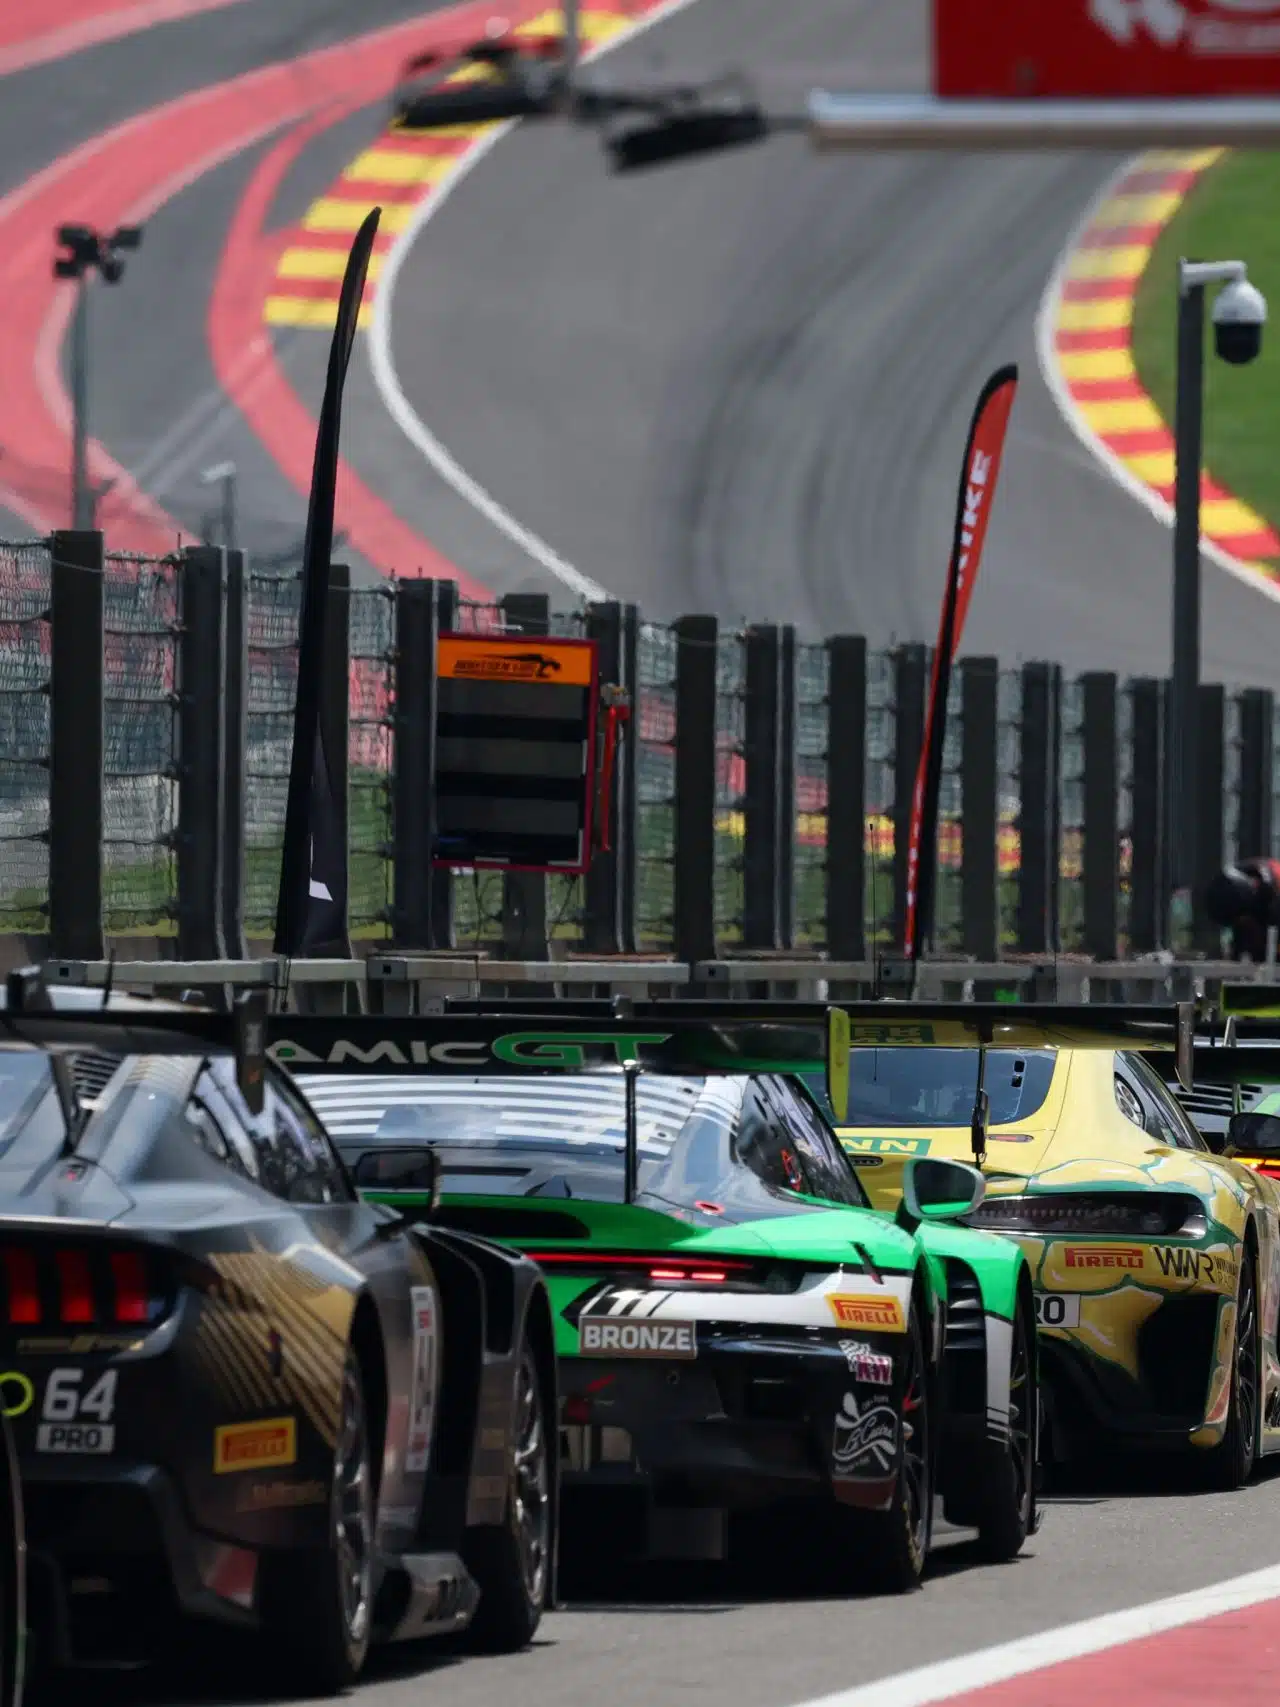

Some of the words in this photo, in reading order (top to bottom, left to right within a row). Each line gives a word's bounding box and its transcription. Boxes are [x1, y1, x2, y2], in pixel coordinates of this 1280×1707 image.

[1063, 1247, 1145, 1269] PIRELLI
[833, 1299, 900, 1325] PIRELLI
[1034, 1295, 1066, 1325] RO
[583, 1324, 692, 1351] BRONZE
[42, 1367, 119, 1422] 64
[49, 1428, 101, 1449] PRO
